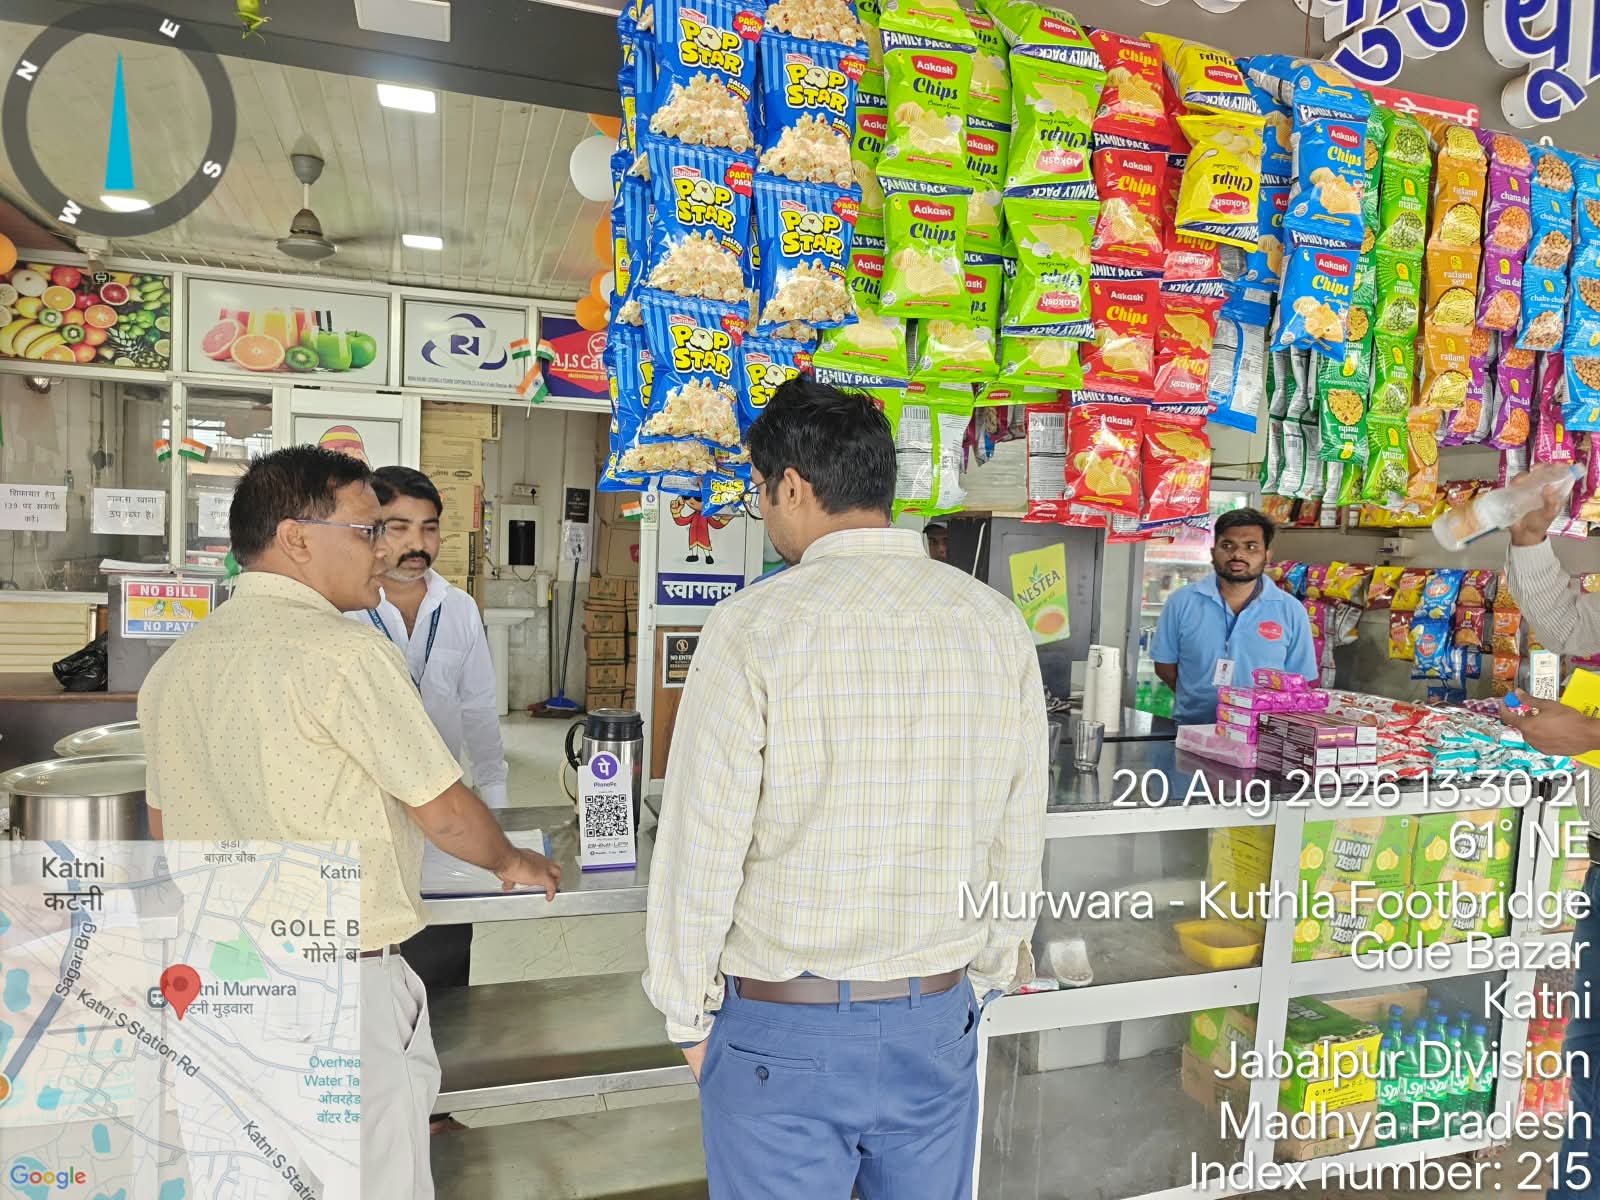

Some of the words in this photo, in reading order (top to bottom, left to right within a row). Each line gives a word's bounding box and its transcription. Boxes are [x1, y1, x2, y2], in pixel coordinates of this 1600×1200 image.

[680, 18, 740, 51] POP
[883, 31, 921, 48] FAMILY
[924, 39, 952, 49] PACK
[679, 41, 744, 76] STAR
[1039, 48, 1066, 61] PACK
[1118, 49, 1159, 68] Chips
[916, 59, 953, 75] Aakash
[785, 63, 848, 90] POP
[913, 77, 957, 101] Chips
[787, 84, 848, 116] STAR
[1206, 95, 1230, 106] PACK
[1299, 104, 1331, 121] FAMILY
[968, 117, 994, 129] PACK
[1040, 128, 1087, 149] Chips
[1095, 133, 1126, 149] FAMILY
[1330, 129, 1358, 143] Aakash
[967, 140, 995, 153] akash
[1126, 138, 1150, 150] PACK
[1042, 155, 1081, 168] Aakash
[1327, 145, 1362, 167] Chips
[967, 156, 998, 176] hips
[1122, 159, 1153, 173] Aakash
[880, 177, 914, 195] FAMILY
[915, 182, 948, 193] PACK
[1118, 176, 1157, 198] Chips
[1213, 171, 1253, 192] Chips
[673, 177, 731, 206] POP
[1032, 186, 1062, 199] PACK
[1500, 191, 1520, 201] chana
[1213, 198, 1249, 208] Aakash
[676, 203, 735, 232] STAR
[914, 205, 951, 217] Aakash
[781, 209, 842, 236] POP
[1203, 224, 1230, 234] PACK
[910, 223, 956, 244] Chips
[1292, 230, 1323, 246] FAMILY
[782, 231, 844, 259] STAR
[1322, 239, 1347, 248] PACK
[964, 253, 982, 263] ACK
[1318, 258, 1349, 273] Aakash
[1090, 264, 1116, 278] AMILY
[1118, 269, 1144, 278] PACK
[1168, 282, 1195, 294] PACK
[1312, 275, 1349, 295] Chips
[1043, 297, 1081, 309] Aakash
[1111, 290, 1144, 302] Aakash
[1106, 305, 1148, 326] Chips
[671, 324, 730, 352] POP
[1029, 325, 1059, 337] PACK
[552, 353, 579, 370] A.J.S
[580, 354, 606, 370] Cat
[674, 350, 732, 378] STAR
[816, 369, 853, 384] FAMILY
[855, 375, 882, 385] PACK
[1170, 379, 1202, 390] Aakash
[1071, 390, 1105, 402] FAMILY
[1107, 394, 1133, 403] PACK
[1101, 414, 1133, 426] Aakash
[140, 585, 160, 597] NO
[165, 585, 197, 597] BILL
[1017, 569, 1062, 608] NESTEA
[143, 621, 163, 632] NO
[1334, 839, 1372, 859] LAHORI
